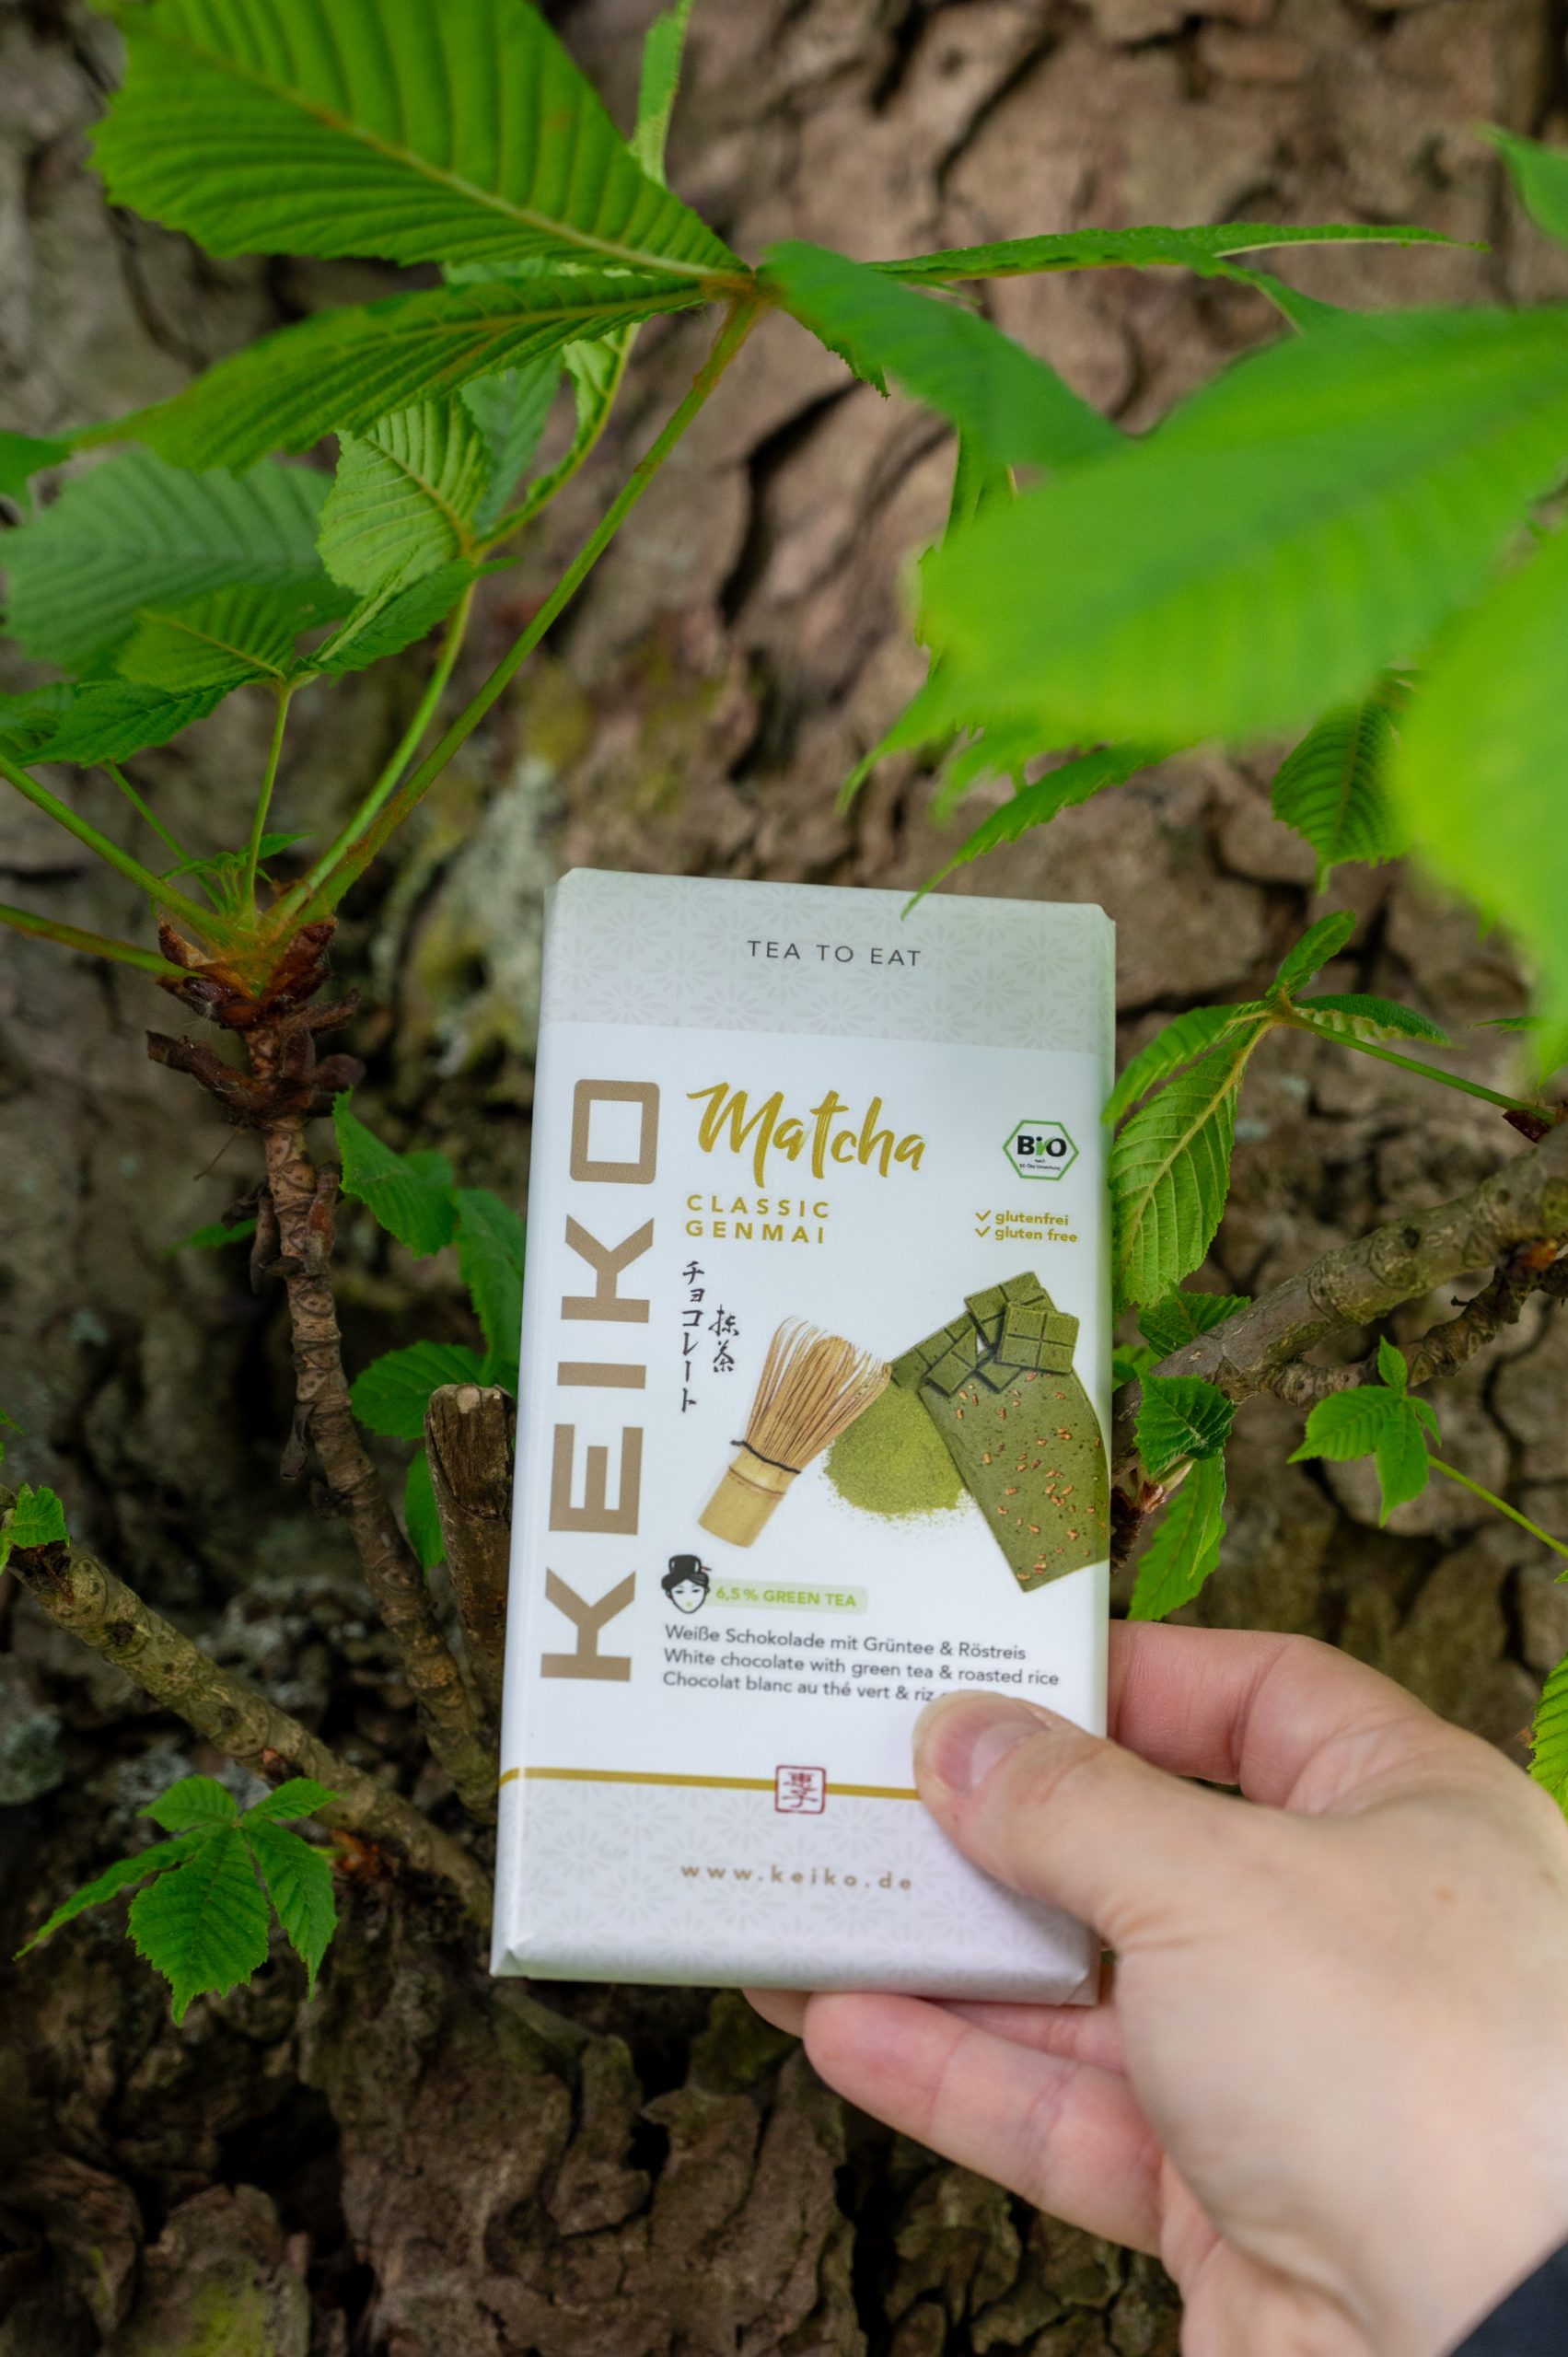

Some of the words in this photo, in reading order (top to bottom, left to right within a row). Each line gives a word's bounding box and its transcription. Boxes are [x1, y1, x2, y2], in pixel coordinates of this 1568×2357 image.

[747, 940, 801, 960] TEA
[815, 944, 854, 963] TO
[870, 947, 922, 967] EAT
[686, 1081, 926, 1190] Matcha
[686, 1194, 830, 1219] CLASSIC
[994, 1209, 1070, 1226] glutenfrei
[684, 1219, 824, 1245] GENMAI
[993, 1225, 1044, 1241] gluten
[1046, 1227, 1079, 1243] free
[680, 1260, 706, 1413] チョコレート
[707, 1304, 740, 1374] 抹茶
[540, 1079, 660, 1682] KEIKO
[761, 1589, 821, 1606] GREEN
[824, 1592, 857, 1608] TEA
[664, 1623, 721, 1643] Weiße
[725, 1627, 826, 1649] Schokolade
[830, 1635, 859, 1651] mit
[863, 1635, 935, 1655] Grüntee
[939, 1641, 953, 1656] &
[958, 1641, 1027, 1661] Röstreis
[663, 1647, 716, 1666] White
[720, 1651, 806, 1671] chocolate
[809, 1657, 846, 1674] with
[851, 1663, 901, 1679] green
[906, 1664, 934, 1679] tea
[938, 1664, 953, 1680] &
[958, 1668, 1023, 1684] roasted
[1028, 1669, 1060, 1686] rice
[662, 1670, 741, 1690] Chocolat
[745, 1675, 793, 1693] blanc
[796, 1682, 819, 1695] au
[822, 1680, 852, 1697] thé
[856, 1686, 890, 1700] vert
[895, 1685, 910, 1701] &
[914, 1687, 935, 1702] riz
[680, 1864, 912, 1891] www.keiko.de
